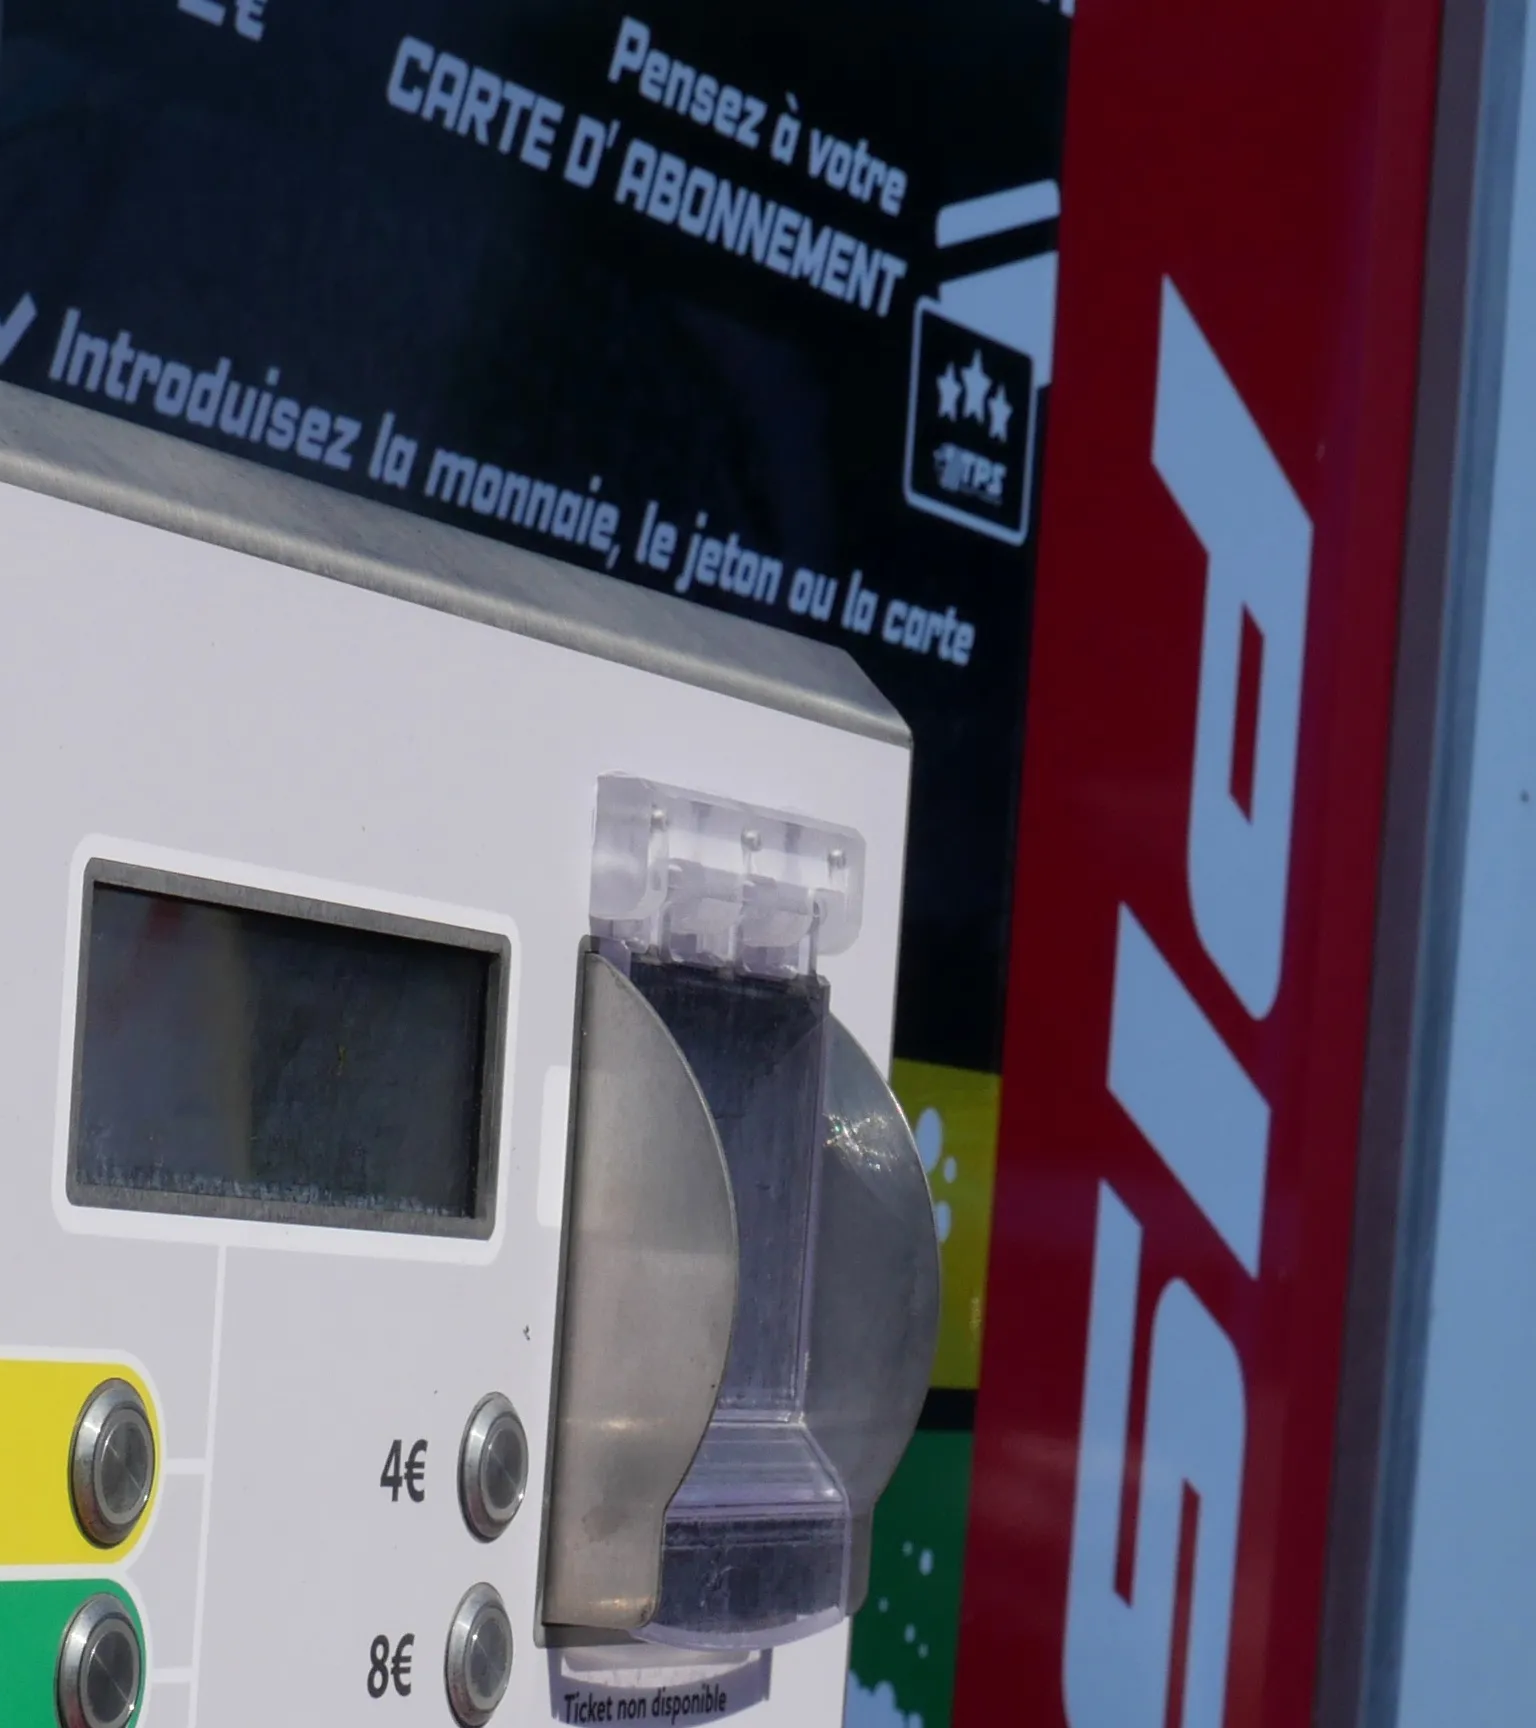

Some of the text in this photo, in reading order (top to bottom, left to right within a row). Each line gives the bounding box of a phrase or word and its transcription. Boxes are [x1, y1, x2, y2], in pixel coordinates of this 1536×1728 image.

[386, 35, 564, 170] CARTE
[608, 16, 908, 217] Pensez à votre
[48, 307, 976, 666] Introduisez la monnaie, le jeton ou la carte
[379, 1438, 428, 1503] 4€
[366, 1632, 415, 1699] 8€
[564, 1684, 728, 1726] Ticket non disponible
